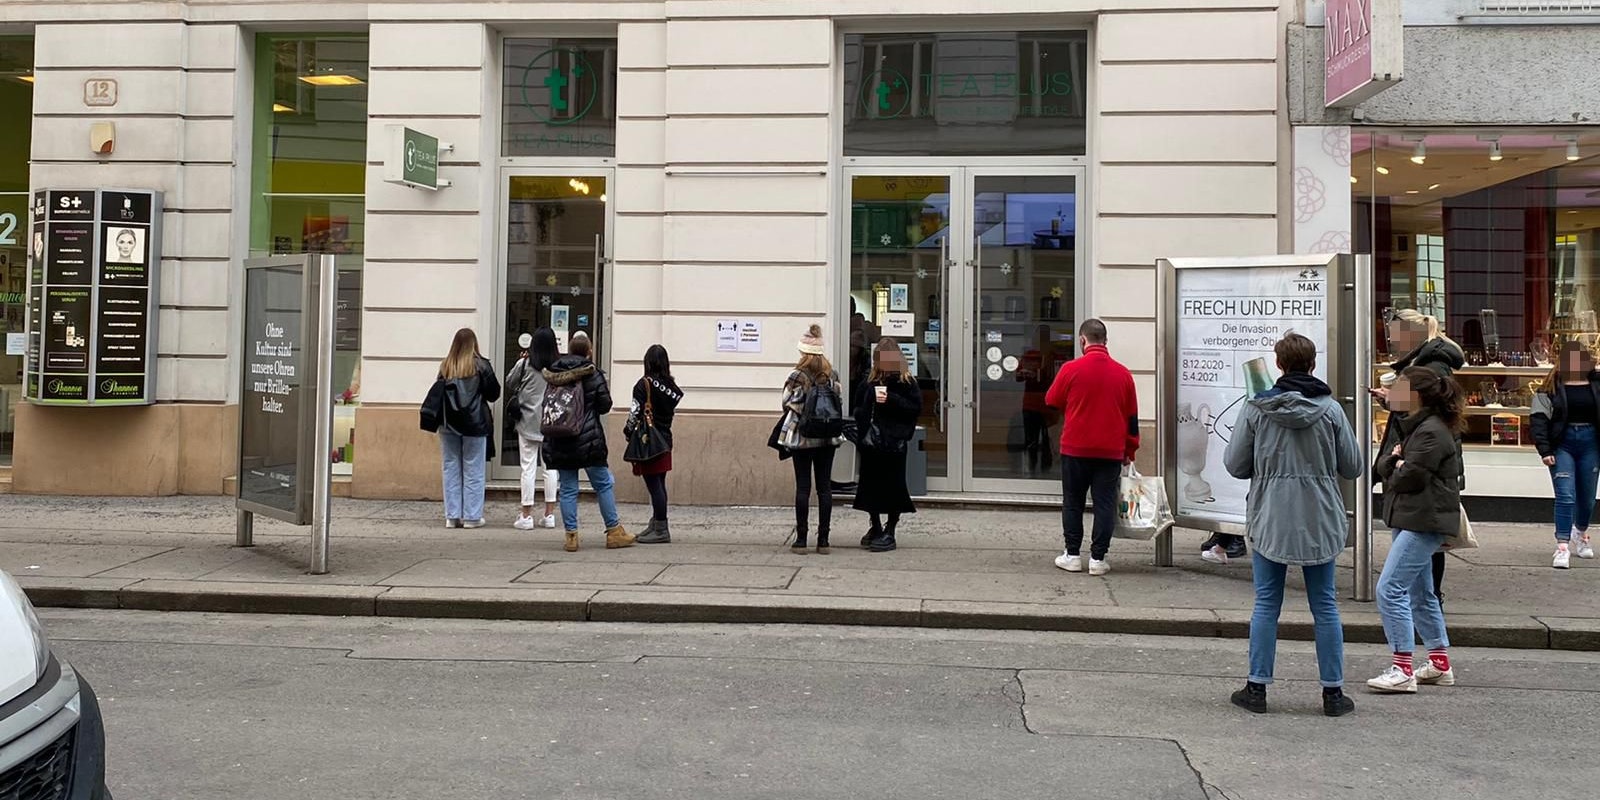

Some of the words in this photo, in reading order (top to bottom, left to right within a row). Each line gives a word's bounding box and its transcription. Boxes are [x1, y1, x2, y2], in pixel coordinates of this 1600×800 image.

[1326, 0, 1369, 61] MAX
[1328, 42, 1370, 78] SCHMUCKDESIGN
[93, 82, 109, 98] 12
[921, 73, 980, 97] TEA
[994, 72, 1072, 96] PLUS
[513, 134, 550, 148] TEA
[558, 134, 605, 149] PLUS
[1297, 283, 1320, 292] MAK
[1184, 300, 1236, 316] FRECH
[1240, 300, 1276, 316] UND
[1281, 300, 1321, 316] FREI!
[265, 323, 284, 338] Ohne
[1222, 323, 1237, 334] Die
[1239, 323, 1278, 334] Invasion
[255, 341, 277, 356] Kultur
[277, 342, 292, 357] sind
[1202, 336, 1258, 348] verborgener
[251, 362, 273, 375] unsere
[274, 361, 295, 377] Ohren
[1182, 360, 1224, 370] 8.12.2020
[1182, 372, 1218, 382] 5.4.2021
[254, 381, 267, 393] nur
[267, 379, 292, 395] Brillen-
[262, 396, 284, 413] halter.
